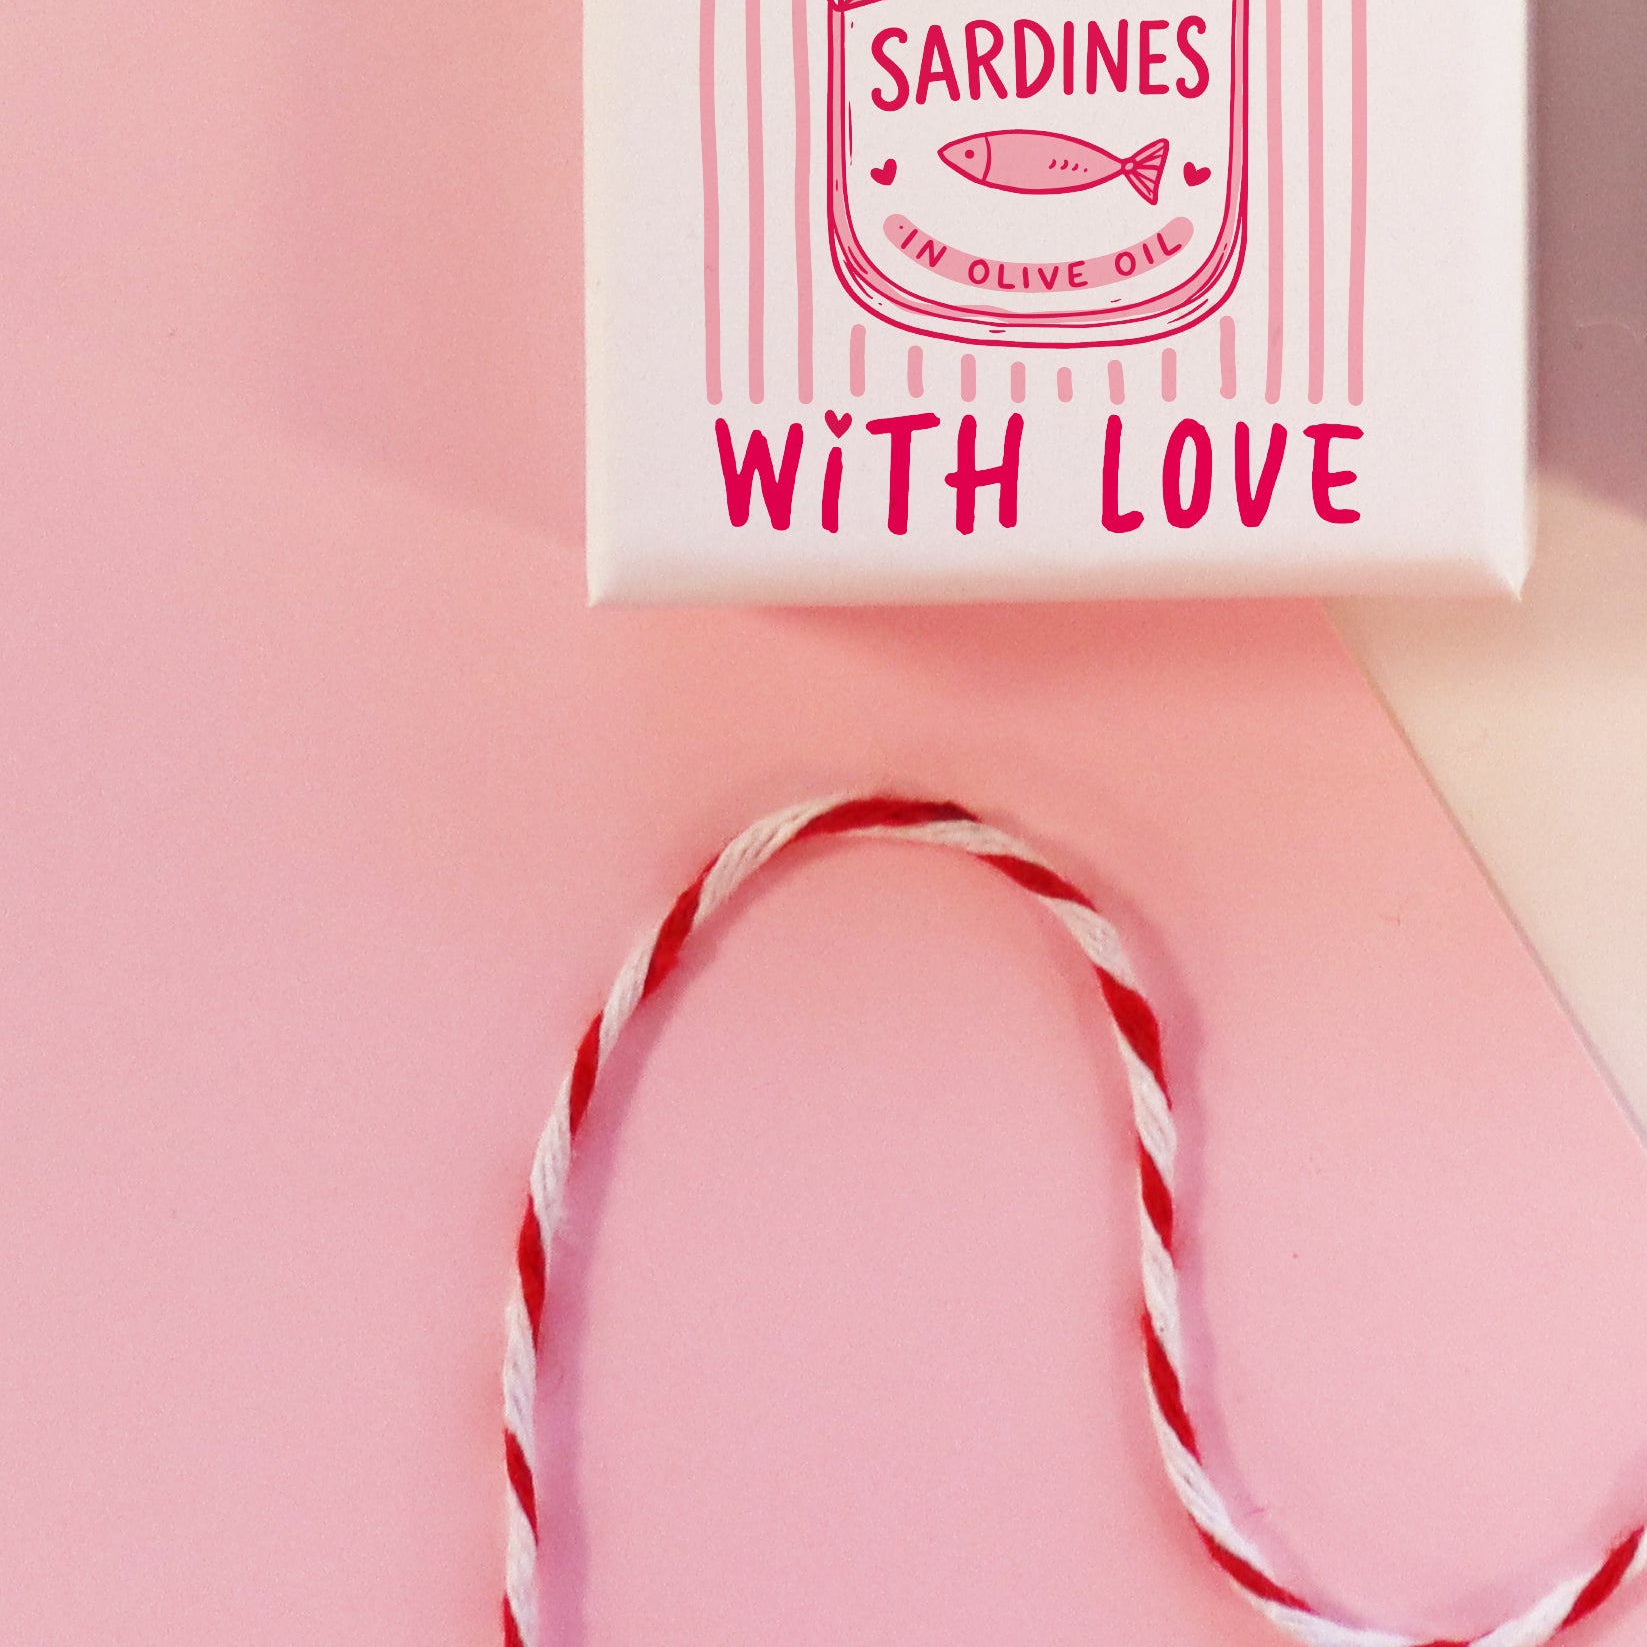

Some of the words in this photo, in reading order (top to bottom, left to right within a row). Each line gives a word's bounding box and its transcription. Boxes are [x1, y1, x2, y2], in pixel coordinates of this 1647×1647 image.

[872, 16, 1209, 111] SARDINES
[901, 227, 947, 267] IN
[968, 259, 1088, 290] OLIVE
[1115, 233, 1182, 276] OIL
[1102, 415, 1364, 533] LOVE
